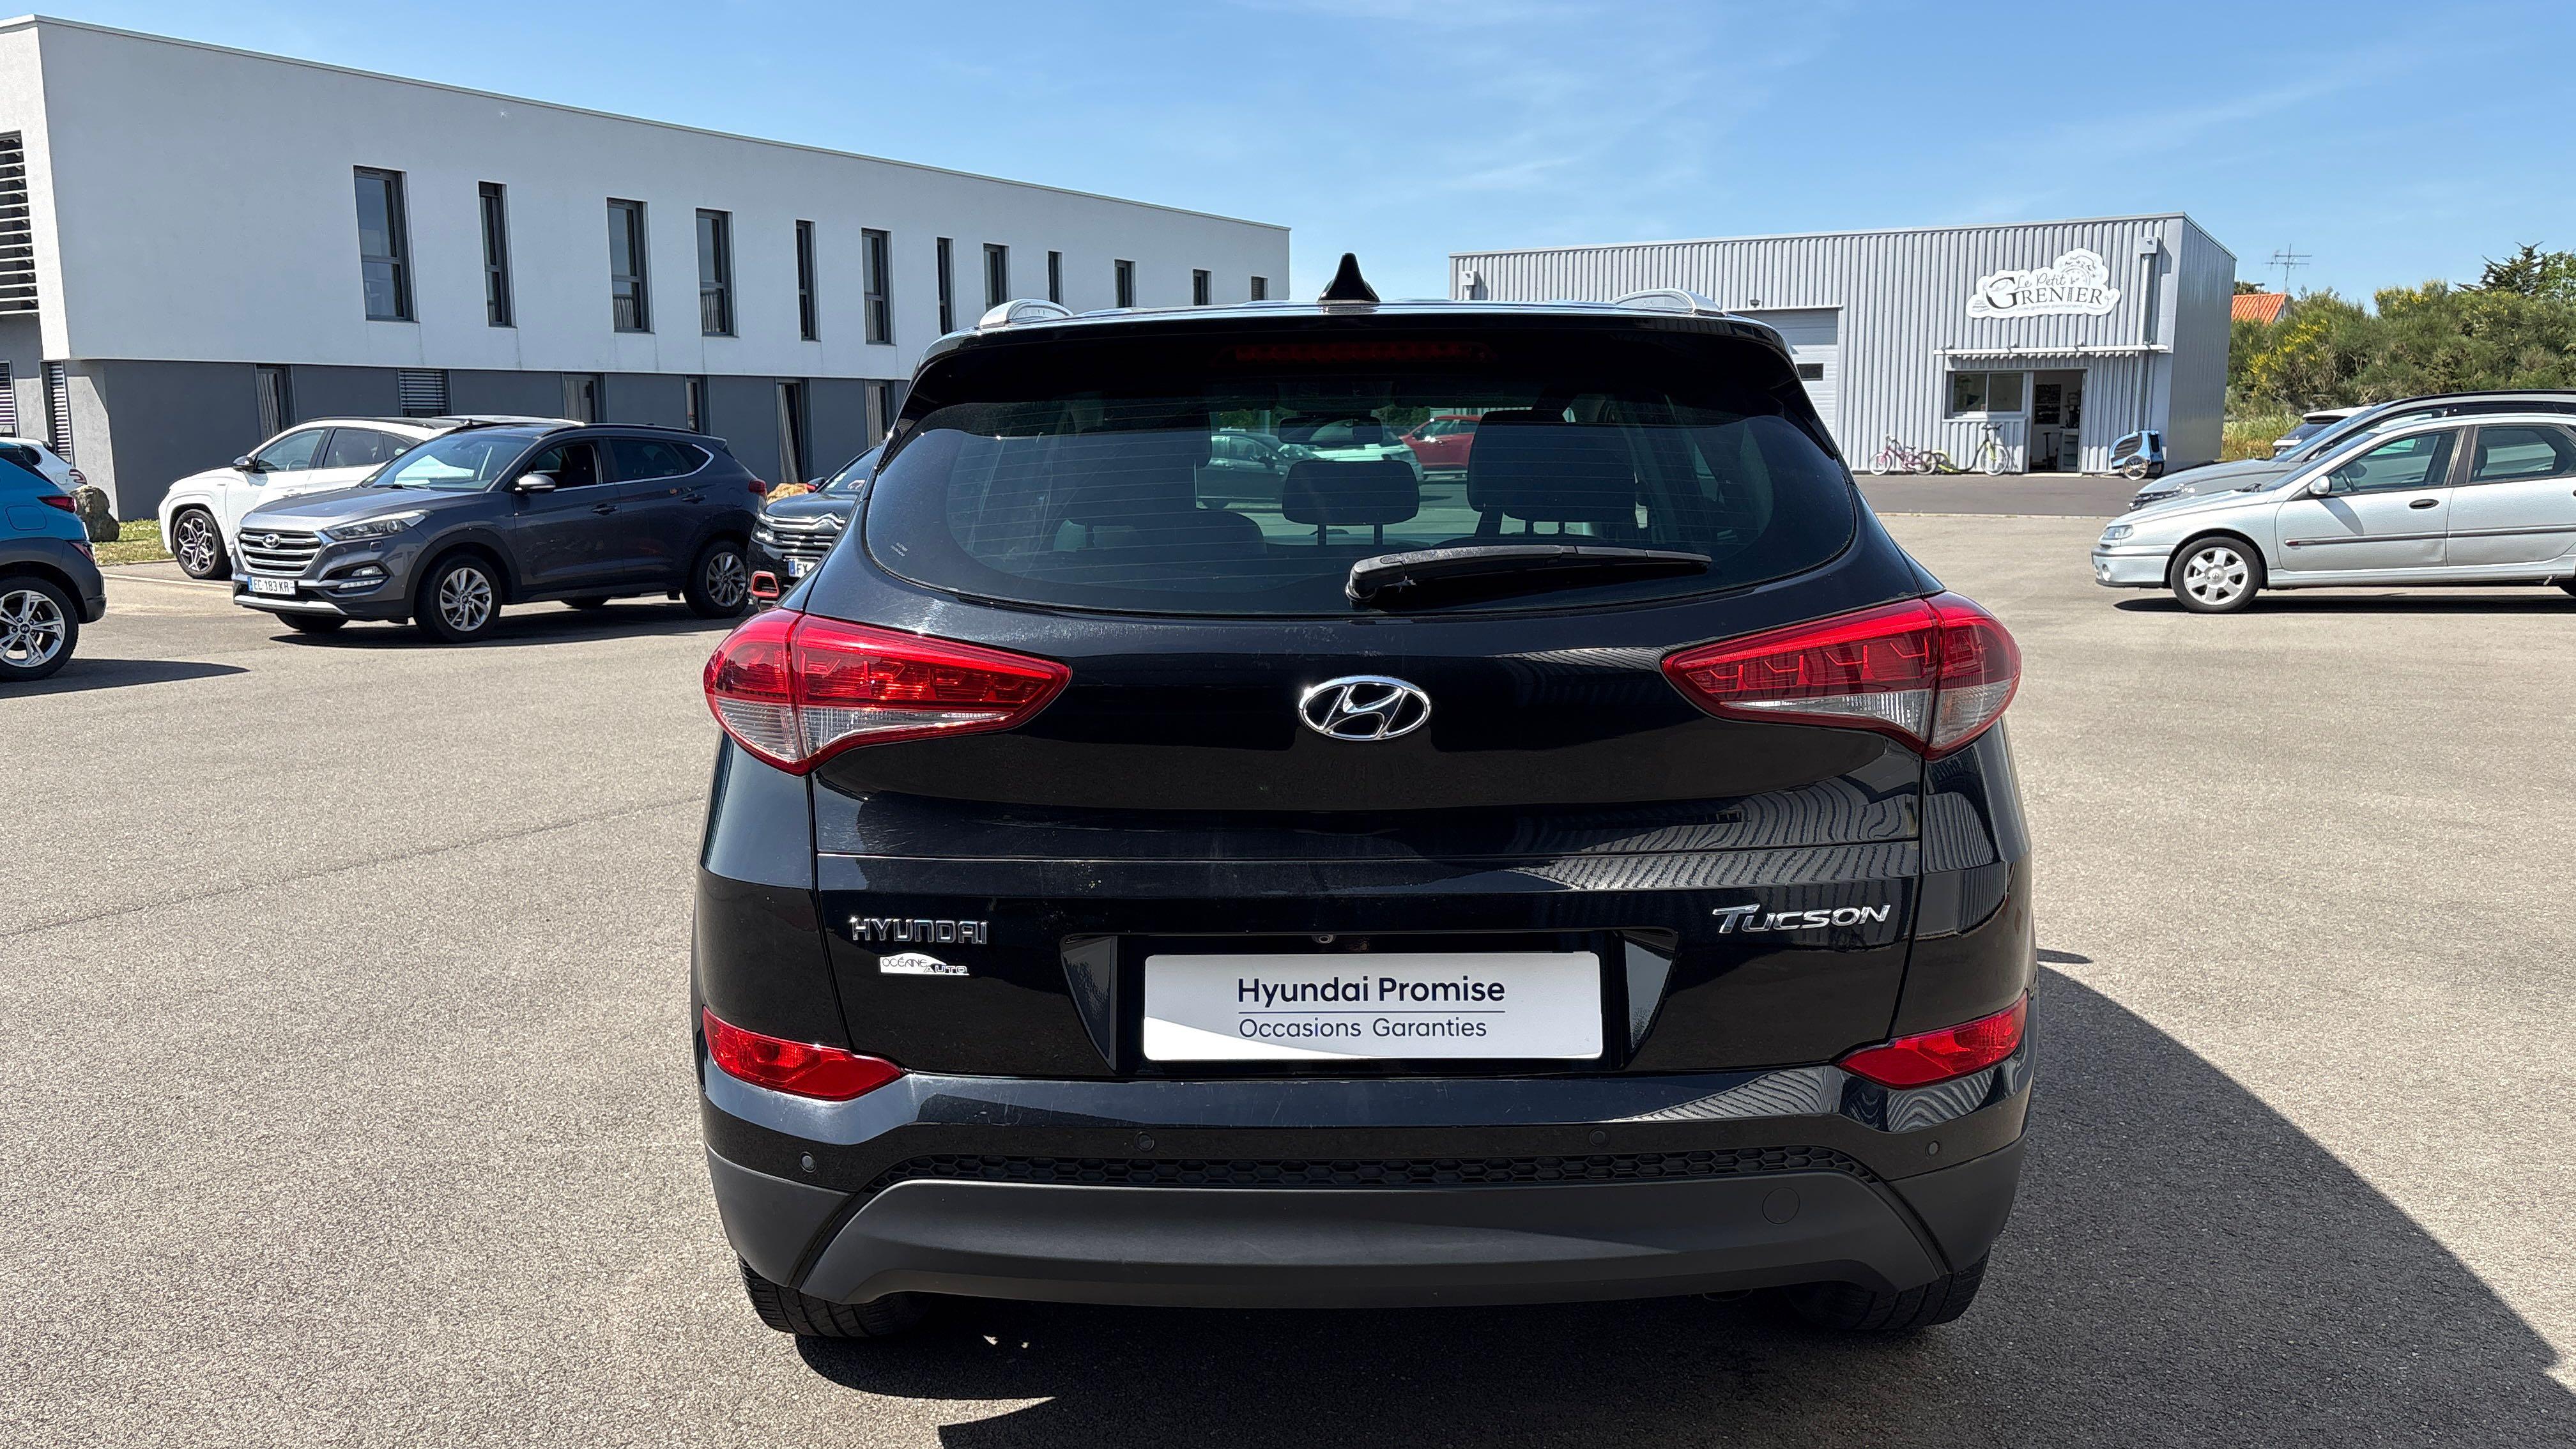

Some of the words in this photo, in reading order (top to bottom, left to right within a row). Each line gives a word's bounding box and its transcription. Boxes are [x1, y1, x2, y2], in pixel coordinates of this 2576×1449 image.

[1986, 277, 2103, 309] GRENIER
[2014, 275, 2032, 290] Le
[2036, 273, 2066, 287] Petit
[850, 916, 988, 945] HYUNDAI
[1712, 904, 1891, 934] TUCSON
[882, 956, 927, 968] OCÉANE
[924, 964, 968, 974] AUTO
[1238, 976, 1369, 1008] Hyundai
[1378, 975, 1506, 1002] Promise
[1239, 1017, 1362, 1038] Occasions
[1372, 1016, 1487, 1038] Garanties
